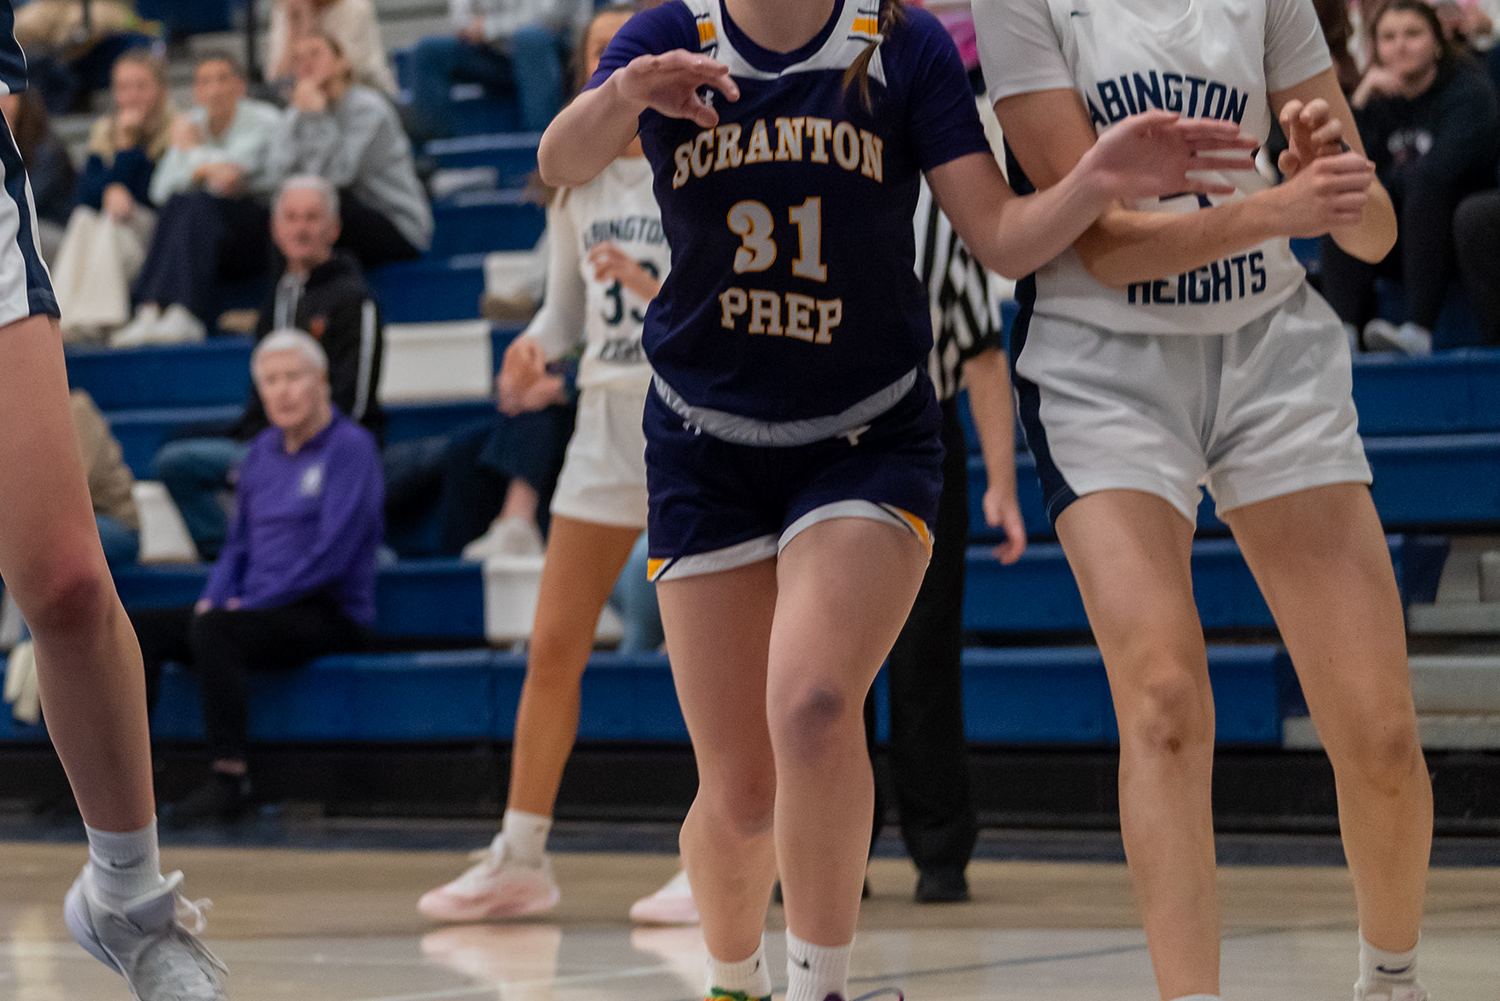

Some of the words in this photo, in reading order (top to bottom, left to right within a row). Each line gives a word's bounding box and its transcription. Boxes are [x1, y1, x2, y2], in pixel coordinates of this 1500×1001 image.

[1086, 70, 1249, 128] ABINGTON
[672, 115, 884, 190] SCRANTON
[726, 196, 828, 283] 31
[718, 287, 843, 345] PREP
